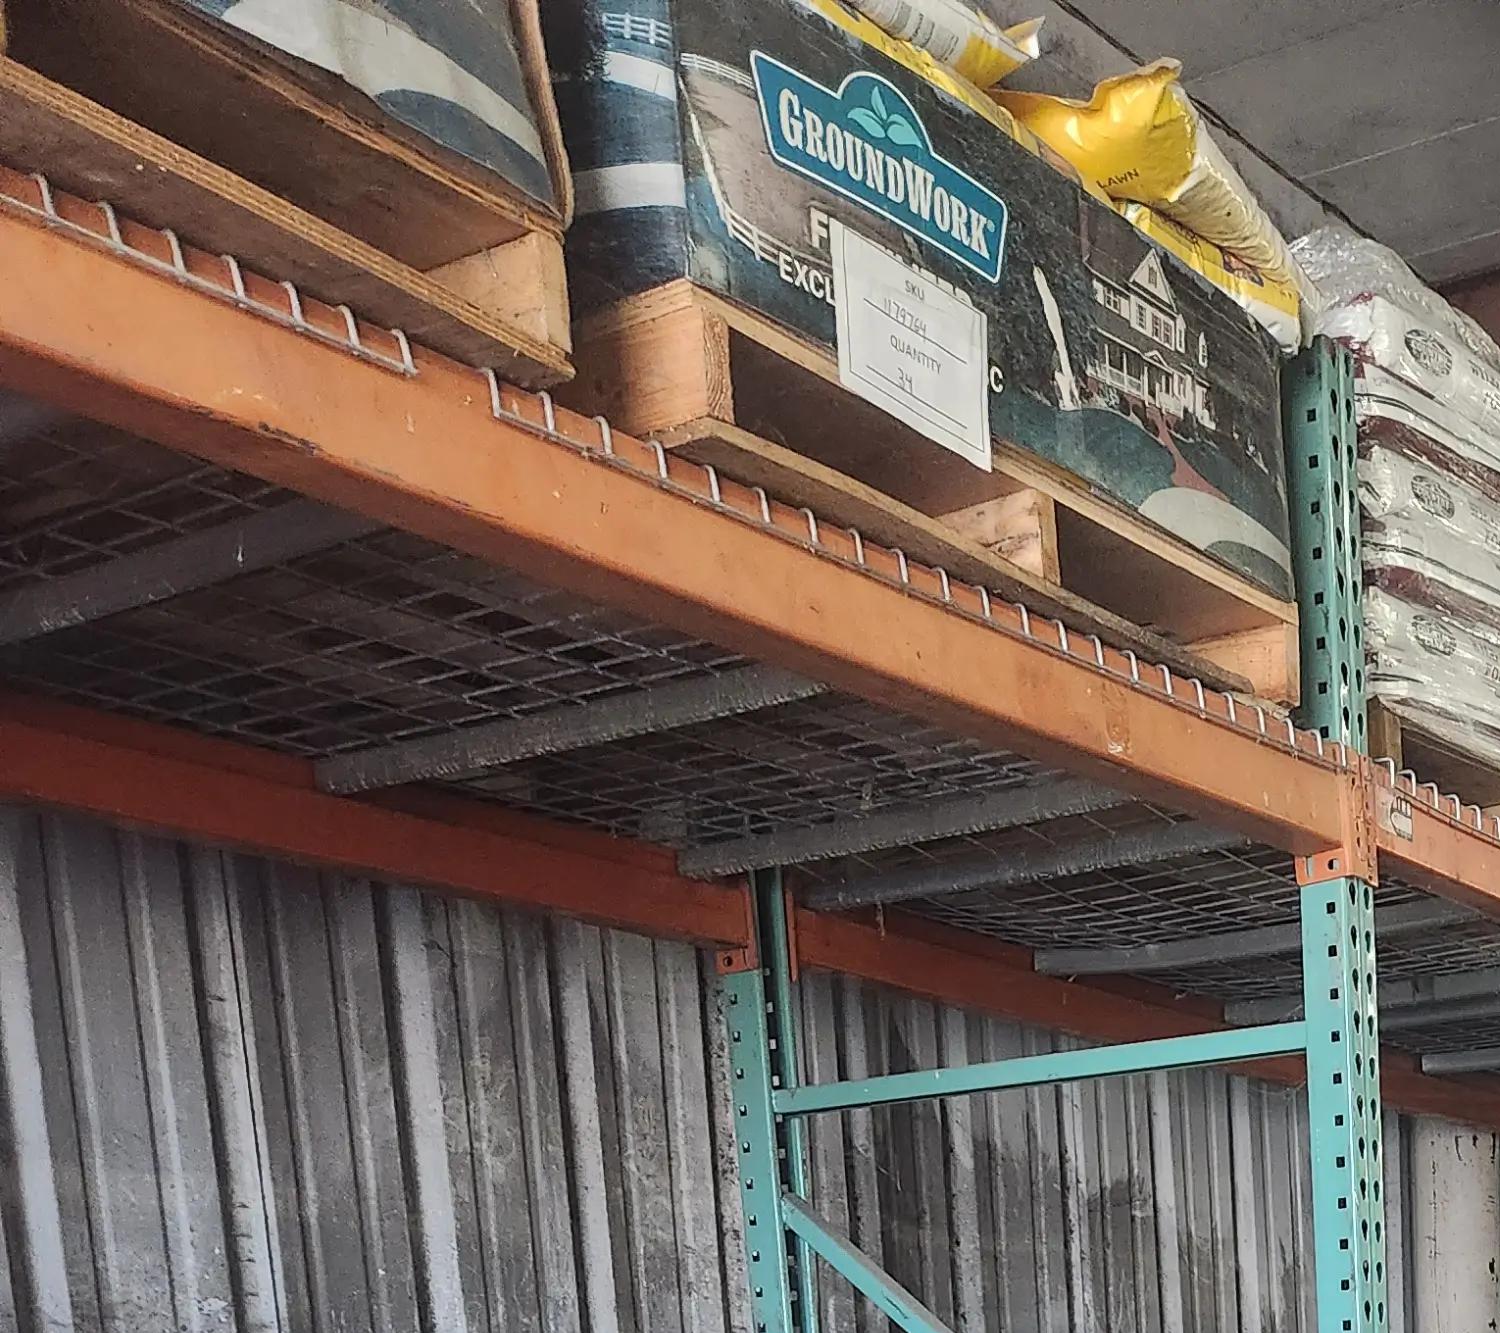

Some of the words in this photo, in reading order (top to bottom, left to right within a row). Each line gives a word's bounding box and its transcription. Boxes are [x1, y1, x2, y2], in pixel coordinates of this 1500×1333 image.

[779, 86, 992, 260] GROUNDWORK
[1096, 169, 1140, 190] LAWN
[904, 279, 926, 300] SKU
[883, 298, 927, 343] 1179764
[889, 334, 941, 375] QUANTITY
[897, 367, 914, 393] 34
